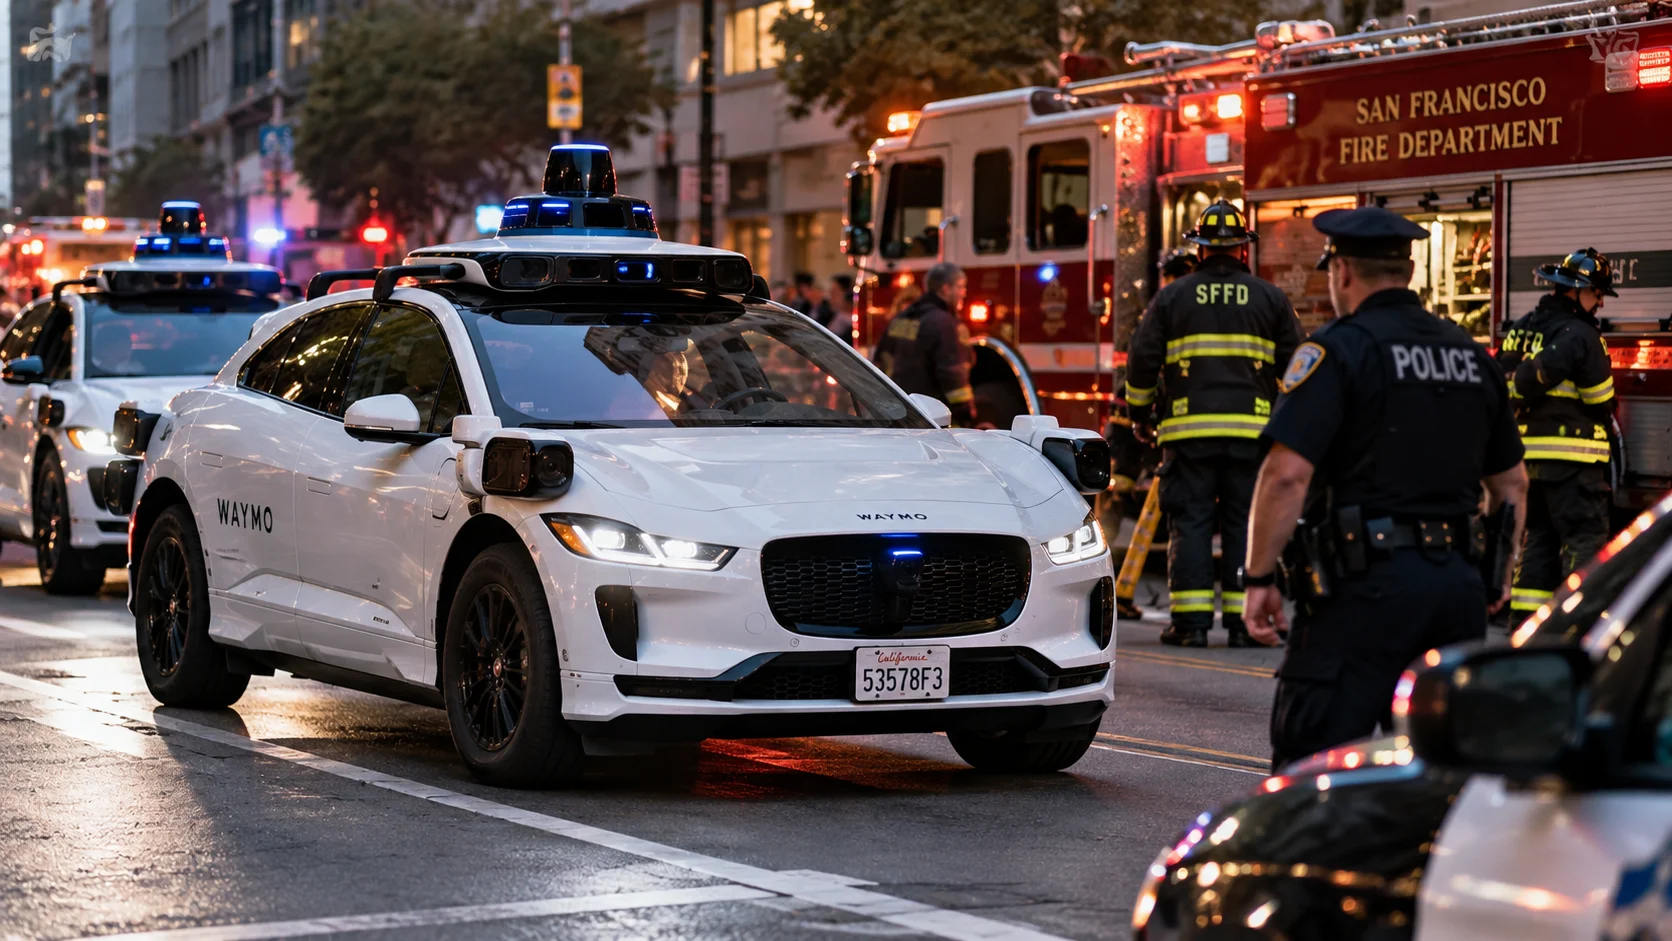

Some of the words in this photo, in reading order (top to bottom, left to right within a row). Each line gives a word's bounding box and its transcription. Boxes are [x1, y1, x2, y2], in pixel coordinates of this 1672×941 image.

[1356, 94, 1400, 125] SAN
[1409, 76, 1547, 119] FRANCISCO
[1339, 135, 1389, 165] FIRE
[1399, 117, 1563, 160] DEPARTMENT
[1196, 283, 1249, 305] SFFD
[1391, 345, 1482, 383] POLICE
[217, 498, 273, 534] WAYMO
[863, 666, 943, 692] 53578F3
